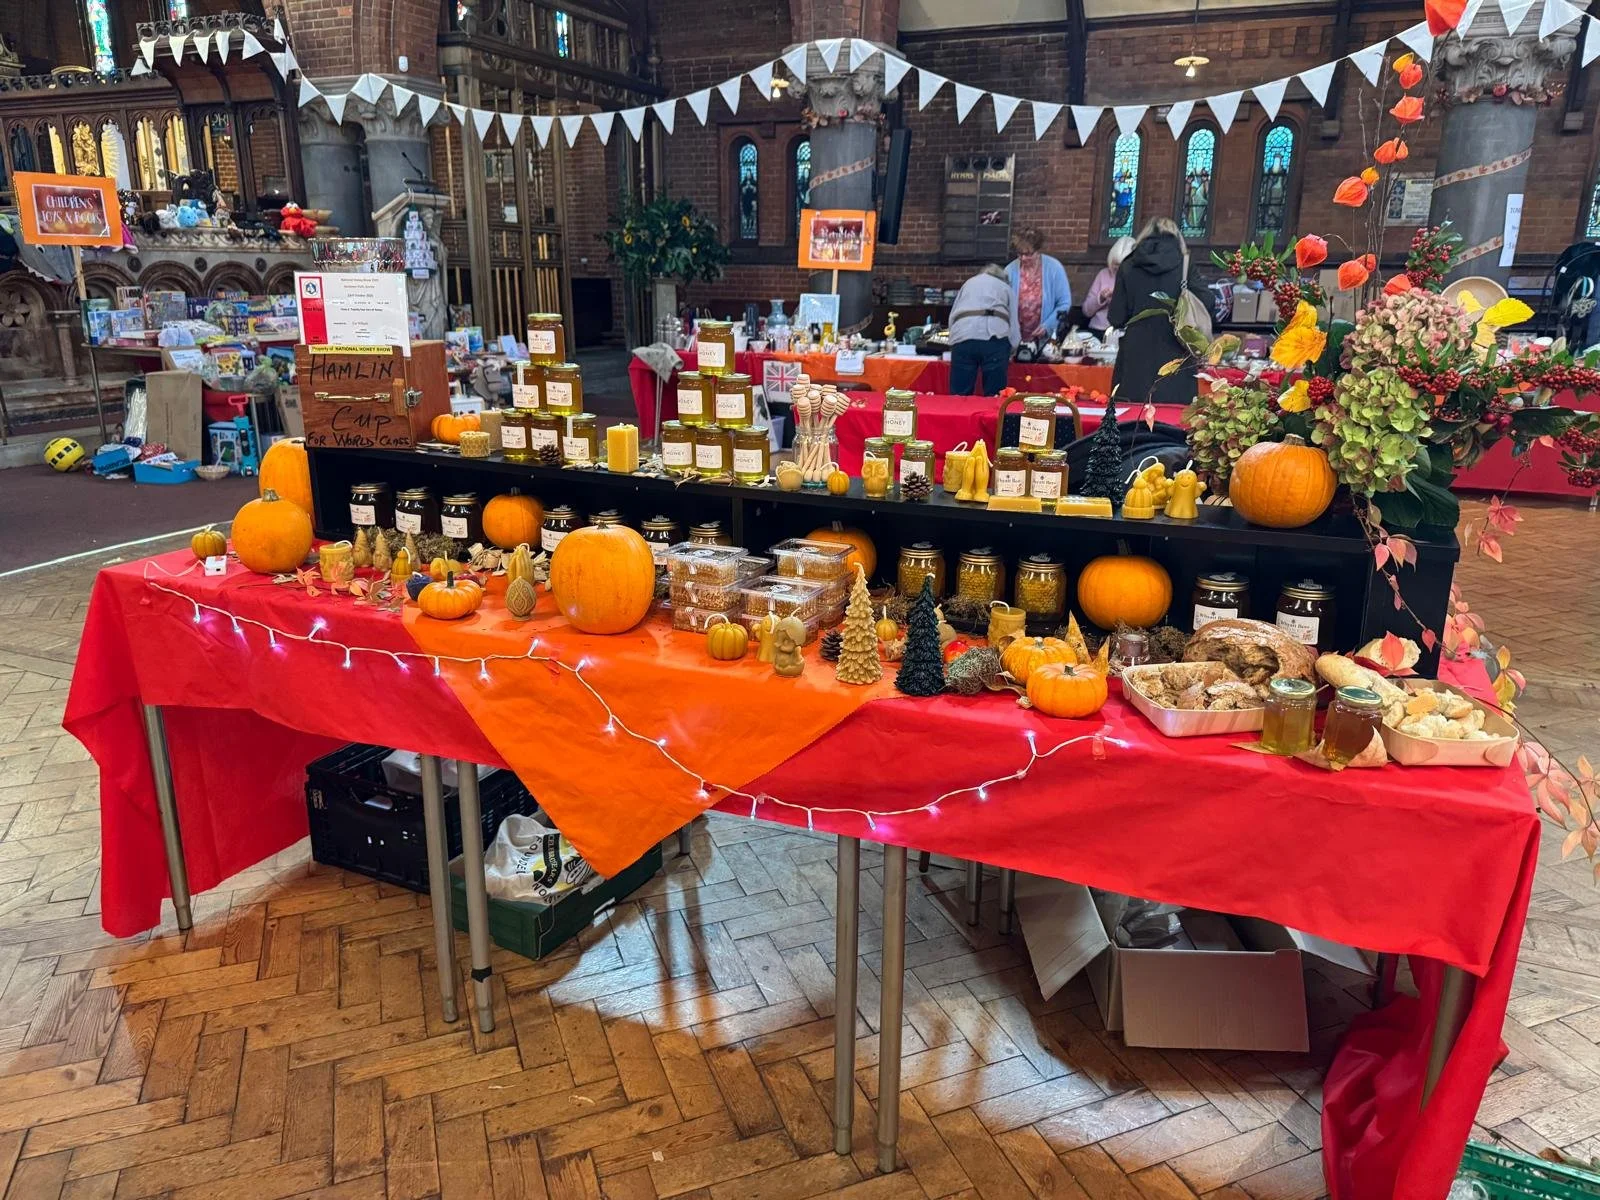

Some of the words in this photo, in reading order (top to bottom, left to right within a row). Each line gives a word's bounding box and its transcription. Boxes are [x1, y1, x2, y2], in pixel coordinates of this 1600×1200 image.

[309, 354, 393, 385] HAMLIN
[307, 431, 326, 446] FOR
[333, 432, 374, 447] WORLD
